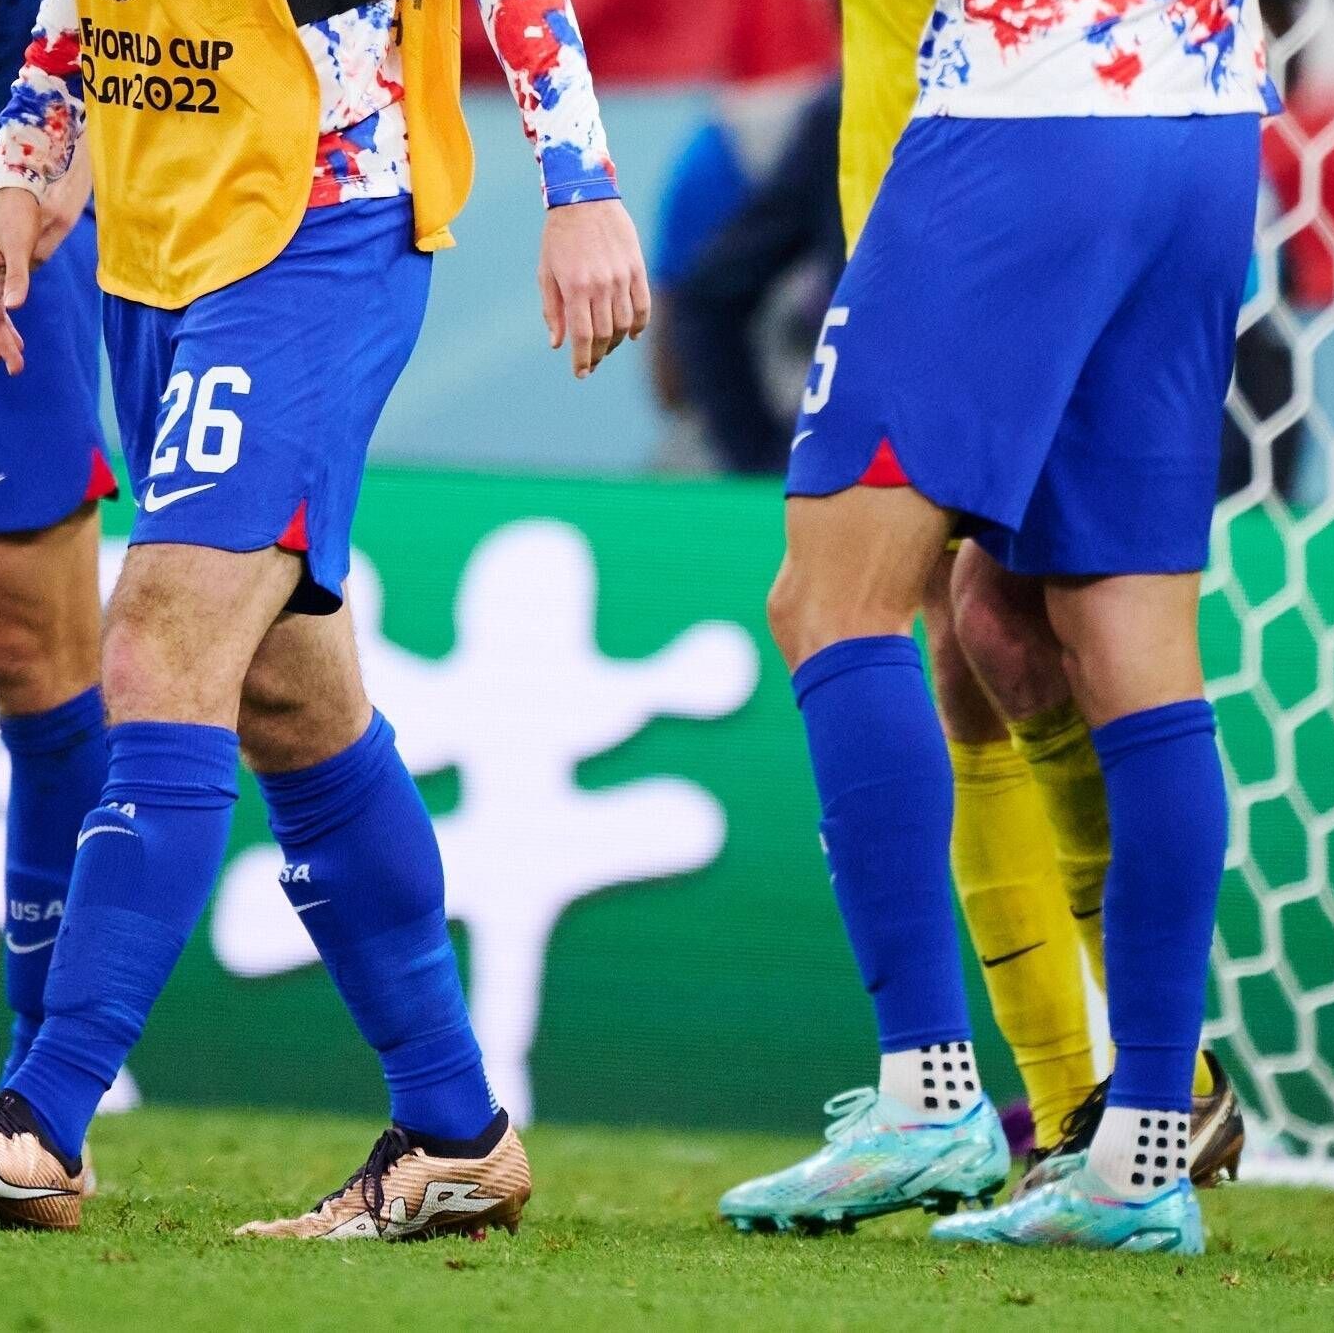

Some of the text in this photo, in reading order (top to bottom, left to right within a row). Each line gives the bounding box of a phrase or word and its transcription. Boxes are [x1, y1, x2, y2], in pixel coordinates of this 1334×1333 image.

[169, 37, 234, 71] CUP
[148, 366, 252, 477] 26
[279, 863, 311, 883] SA
[10, 899, 64, 922] USA
